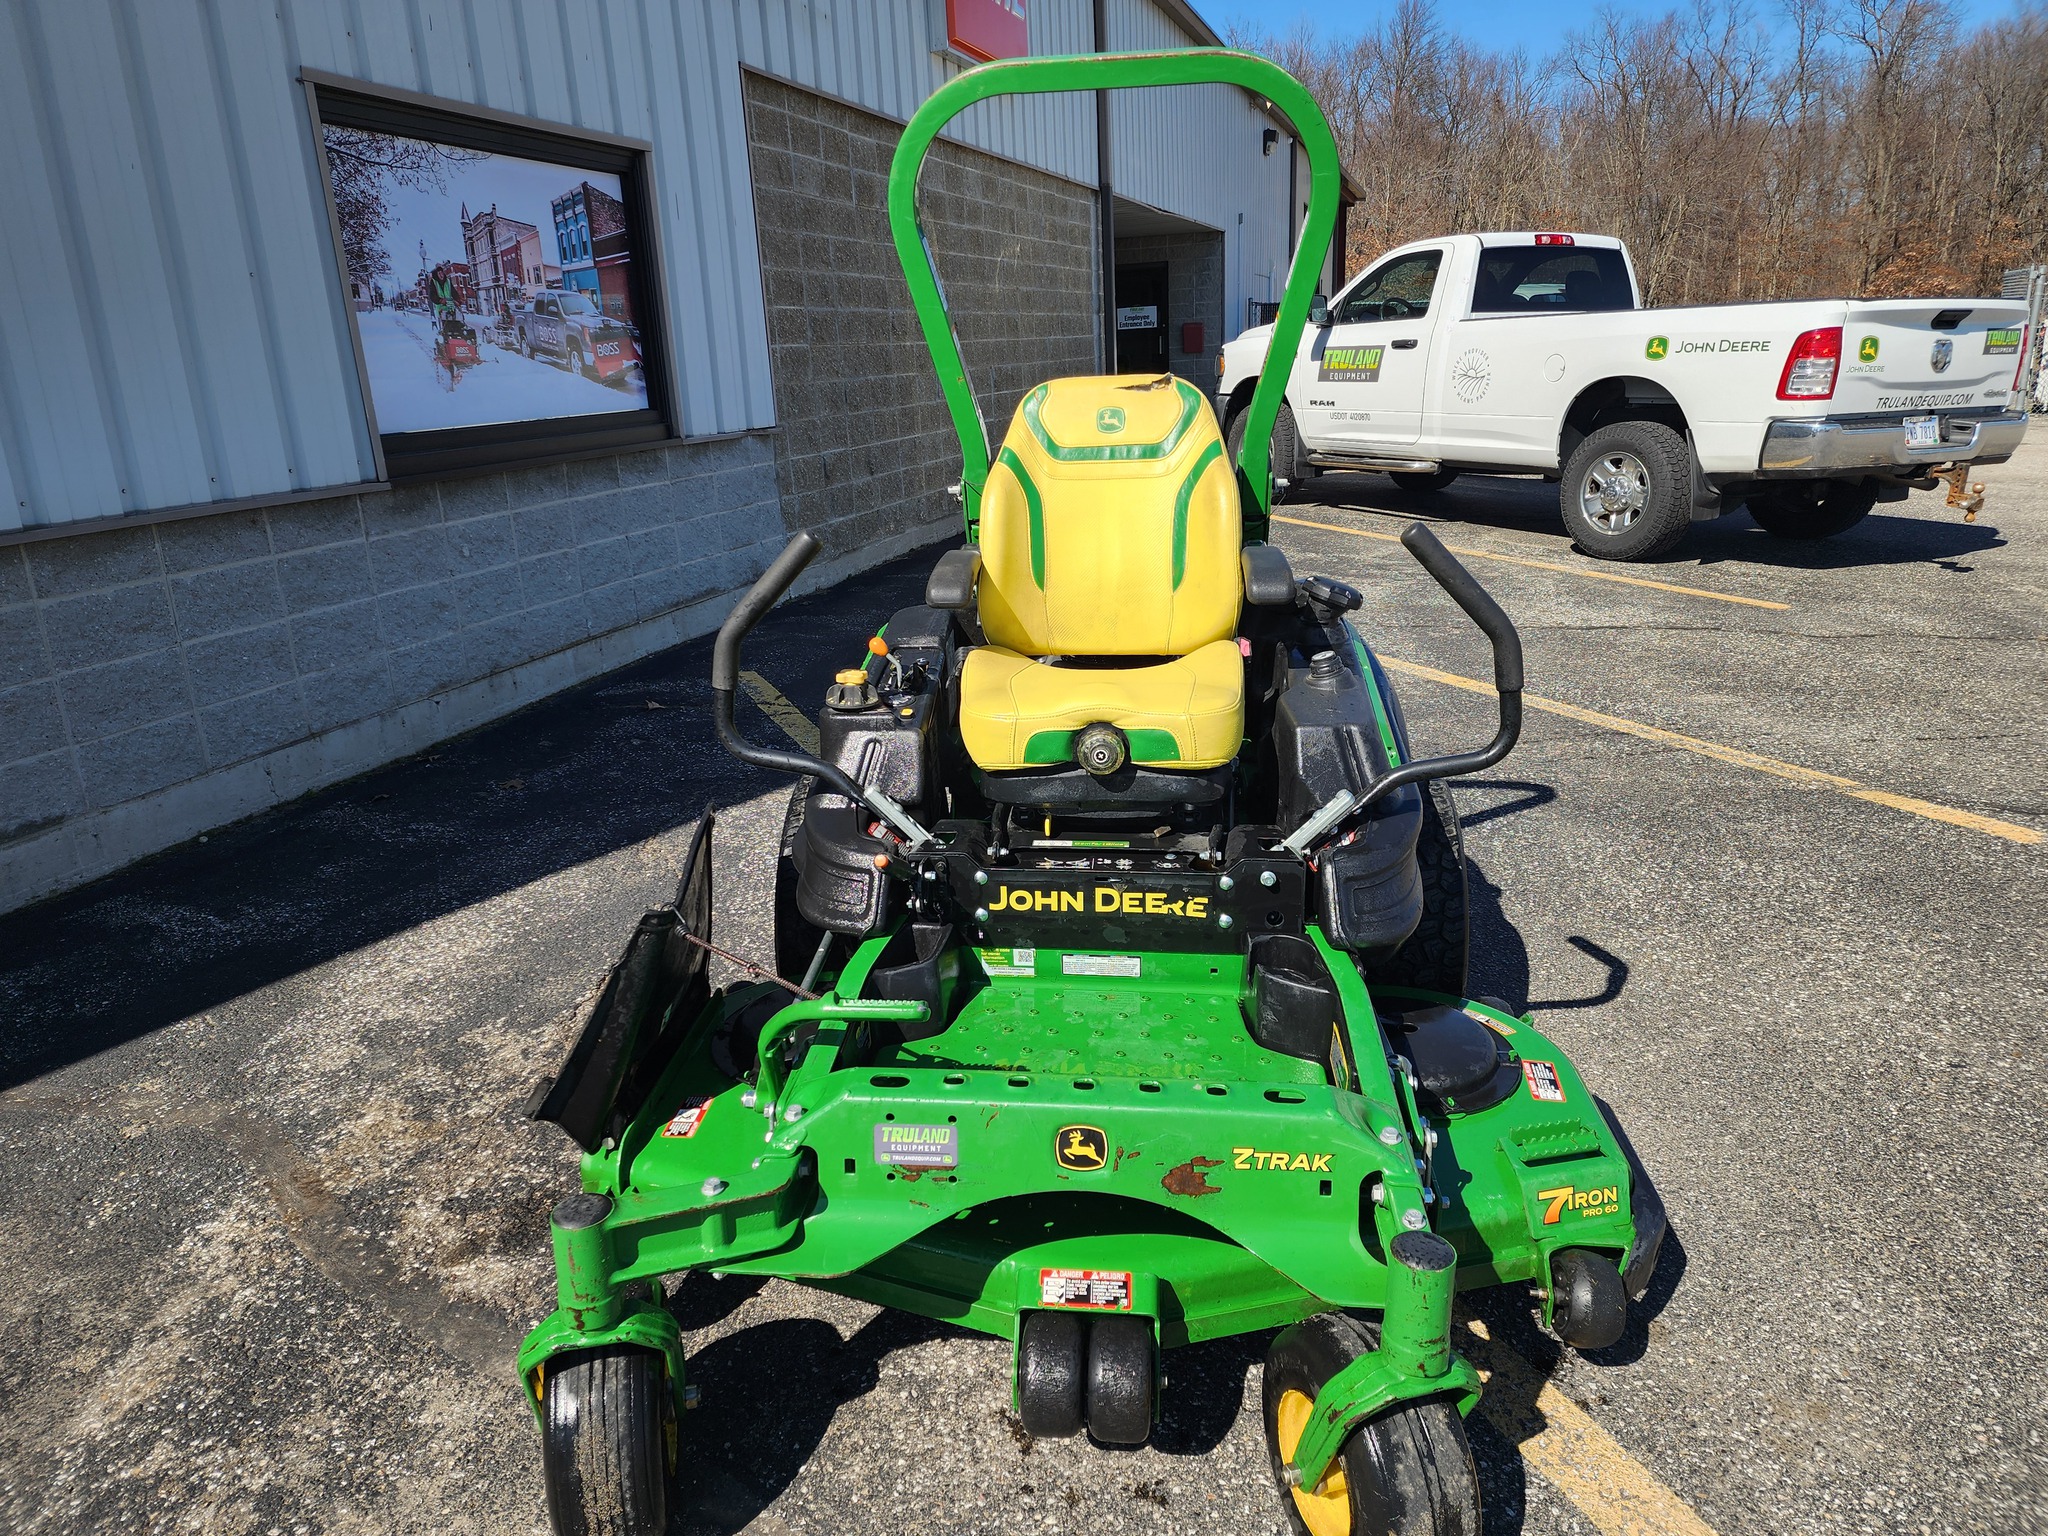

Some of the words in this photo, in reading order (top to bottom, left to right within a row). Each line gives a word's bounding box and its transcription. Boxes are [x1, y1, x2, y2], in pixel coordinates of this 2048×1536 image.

[539, 326, 557, 344] BOSS
[1986, 331, 2019, 346] TRULAND
[455, 346, 469, 354] BOSS
[596, 341, 620, 357] BOSS
[1675, 341, 1716, 354] JOHN
[1718, 339, 1771, 352] DEERE
[1323, 348, 1381, 370] TRULAND
[1329, 372, 1371, 380] EQUIPMENT
[1846, 365, 1864, 373] JOHN
[1864, 365, 1885, 373] DEERE
[1876, 393, 1974, 409] TRULANDEQUIP.COM
[1329, 411, 1348, 421] USDOT
[1919, 425, 1937, 439] 7818
[988, 885, 1084, 912] JOHN
[881, 1126, 951, 1145] TRULAND
[890, 1143, 942, 1153] EQUIPMENT
[1232, 1147, 1335, 1173] ZTRAK
[1582, 1207, 1603, 1218] PRO
[1604, 1204, 1619, 1214] 60
[1059, 1270, 1084, 1279] DANGER
[1100, 1272, 1126, 1280] PELIGRO
